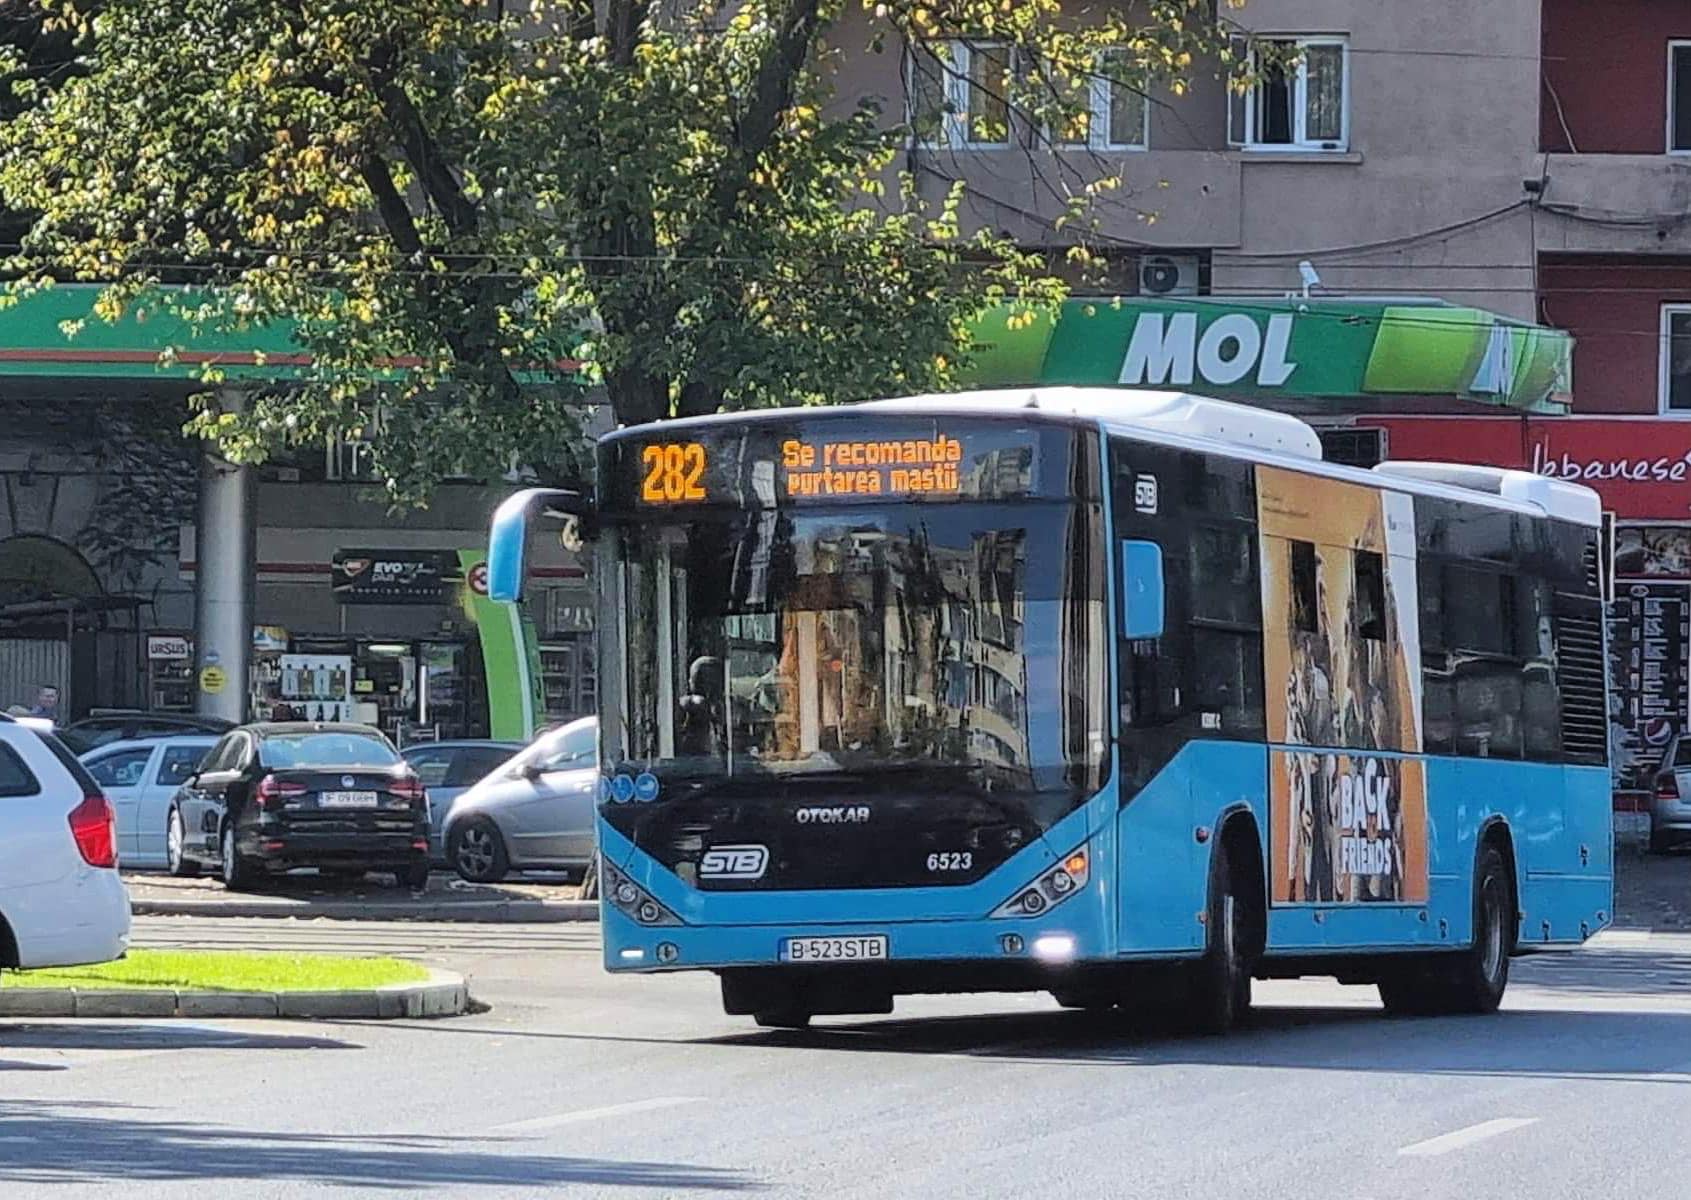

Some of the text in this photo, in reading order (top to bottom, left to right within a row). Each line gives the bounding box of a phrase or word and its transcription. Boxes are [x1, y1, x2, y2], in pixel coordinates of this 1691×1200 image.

[1118, 312, 1297, 386] MOL
[783, 434, 961, 467] Se recomanda
[642, 443, 706, 501] 282
[1341, 758, 1391, 831] BACK
[796, 807, 870, 823] OTOKAR
[700, 849, 765, 875] STB
[927, 852, 972, 870] 6523
[1341, 837, 1392, 875] FRIENDS
